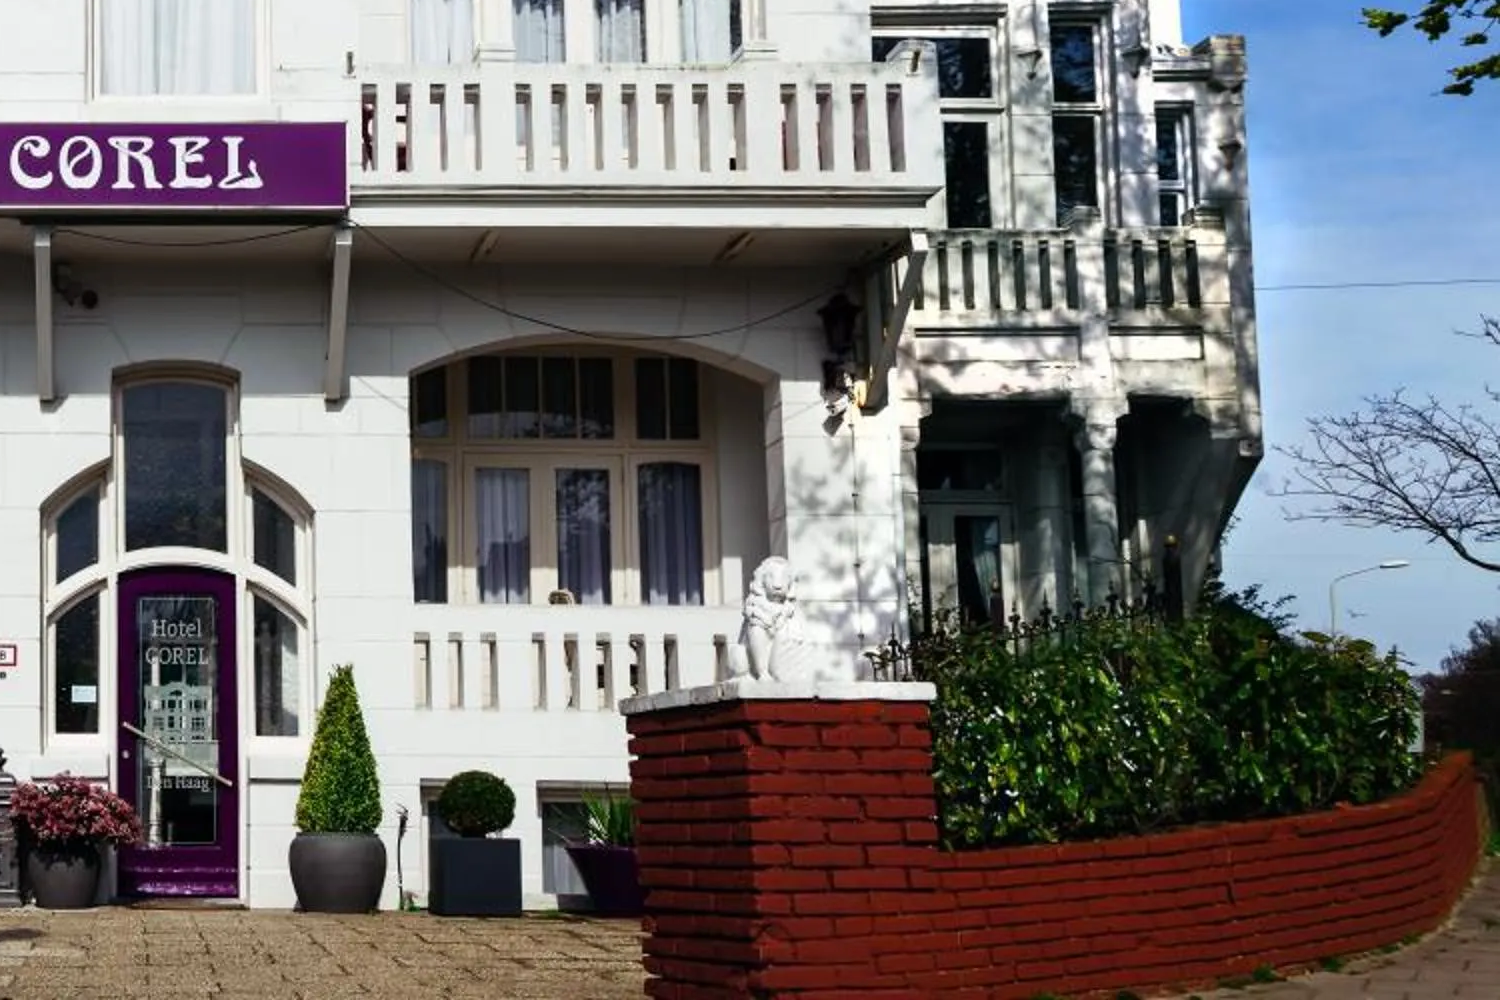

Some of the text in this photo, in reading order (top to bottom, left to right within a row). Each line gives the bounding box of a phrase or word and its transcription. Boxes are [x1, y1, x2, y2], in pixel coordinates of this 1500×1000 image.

[9, 135, 264, 190] COREL
[151, 617, 202, 637] Hotel
[145, 646, 209, 665] COREL
[146, 775, 210, 793] Dn Haag
